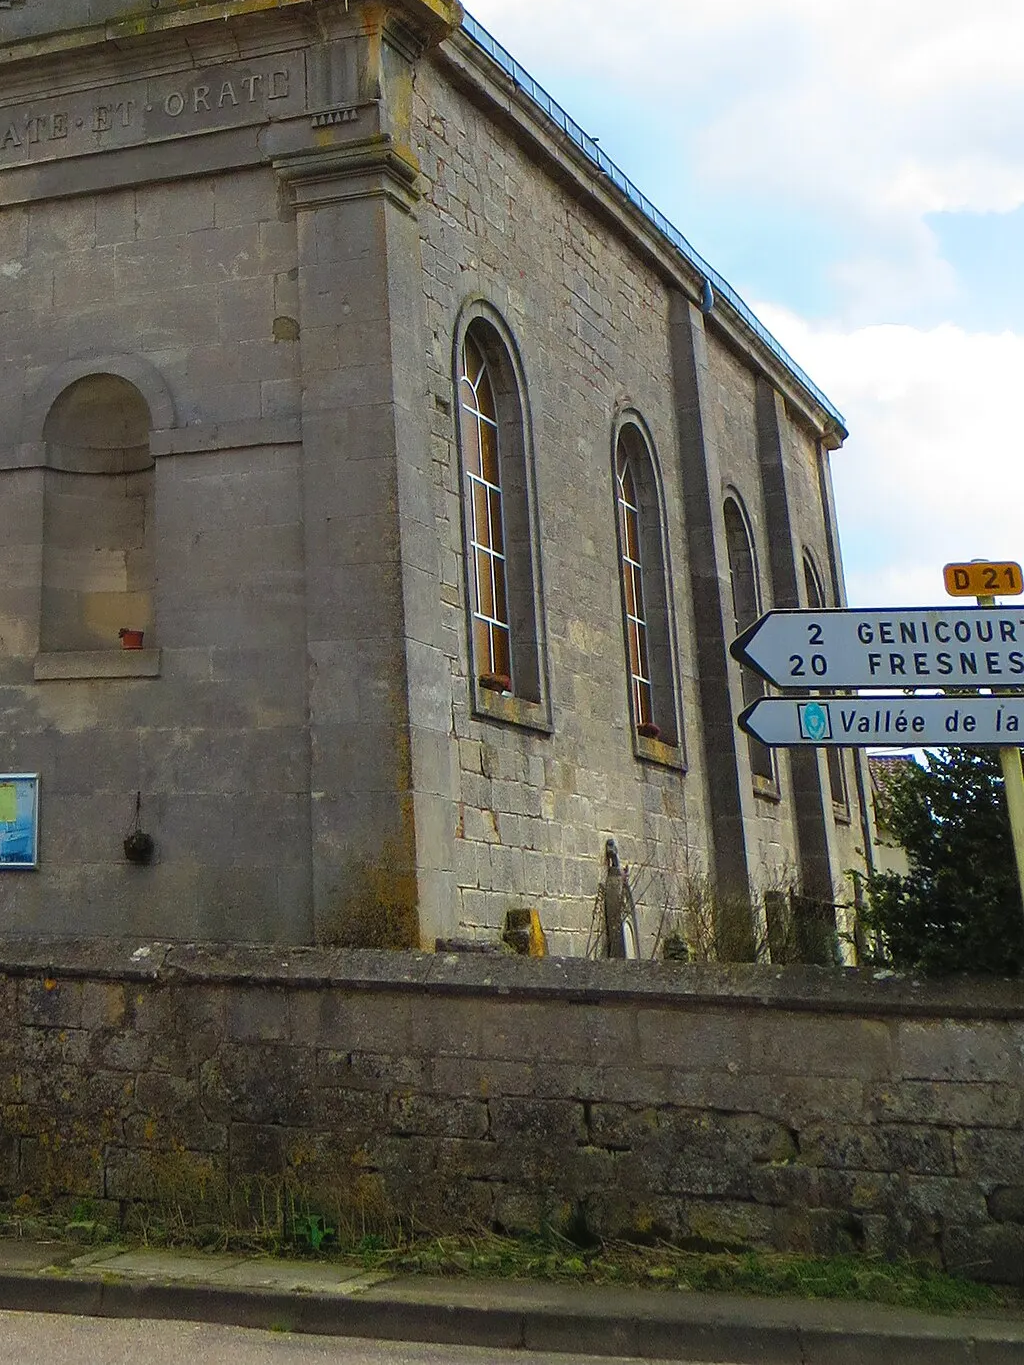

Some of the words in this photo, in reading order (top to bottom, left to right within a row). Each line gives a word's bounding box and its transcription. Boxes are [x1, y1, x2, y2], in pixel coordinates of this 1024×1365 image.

[91, 99, 136, 134] ET
[164, 69, 289, 117] ORATE
[953, 568, 970, 590] D
[983, 567, 1016, 590] 21
[807, 623, 824, 645] 2
[857, 620, 1024, 644] GENICOUR
[789, 654, 828, 676] 20
[868, 652, 1024, 675] FRESNES
[840, 709, 925, 733] Vallée
[945, 709, 976, 732] de
[995, 708, 1019, 732] la
